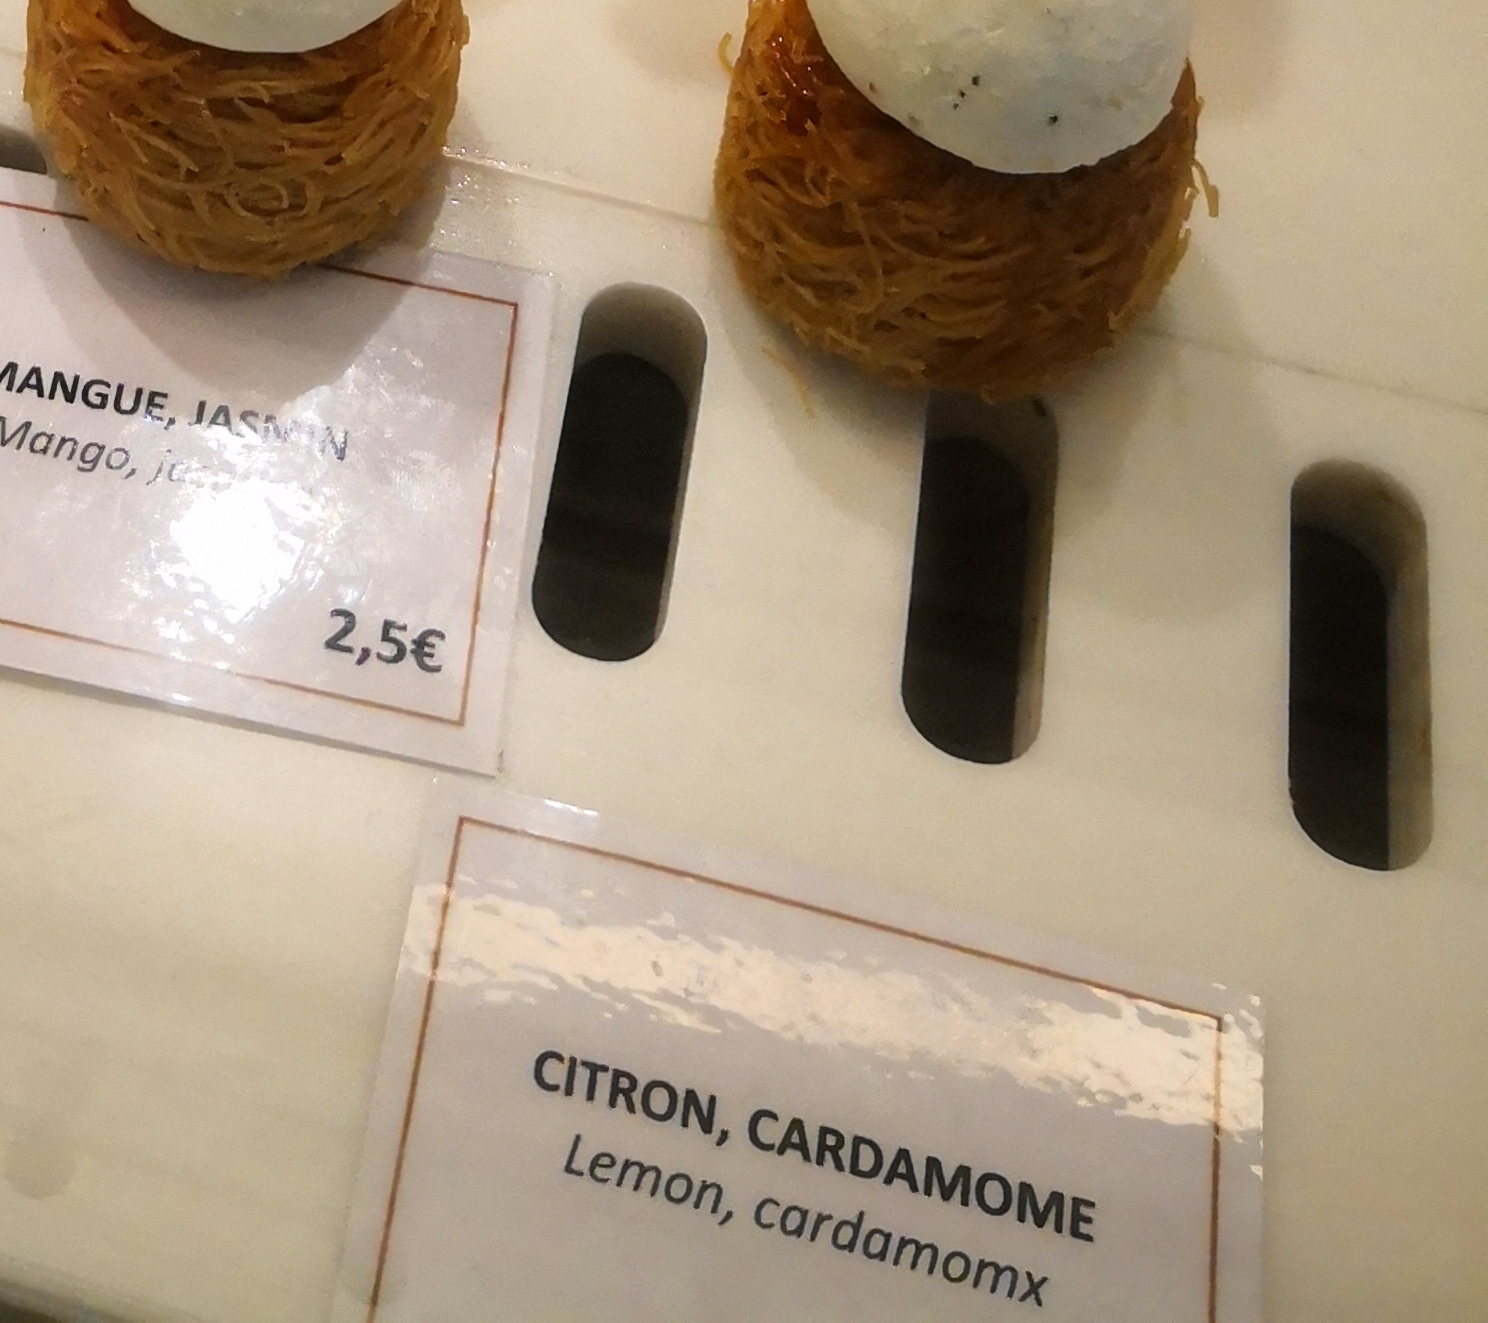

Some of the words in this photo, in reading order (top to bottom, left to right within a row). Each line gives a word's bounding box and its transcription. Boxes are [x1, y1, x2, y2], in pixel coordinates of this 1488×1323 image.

[185, 398, 349, 461] JASMN
[323, 608, 446, 674] 2,5€
[533, 1050, 730, 1147] CITRON,
[747, 1109, 1096, 1243] CARDAMOME
[563, 1134, 734, 1227] Lemon,
[754, 1197, 1049, 1307] cardamomx
